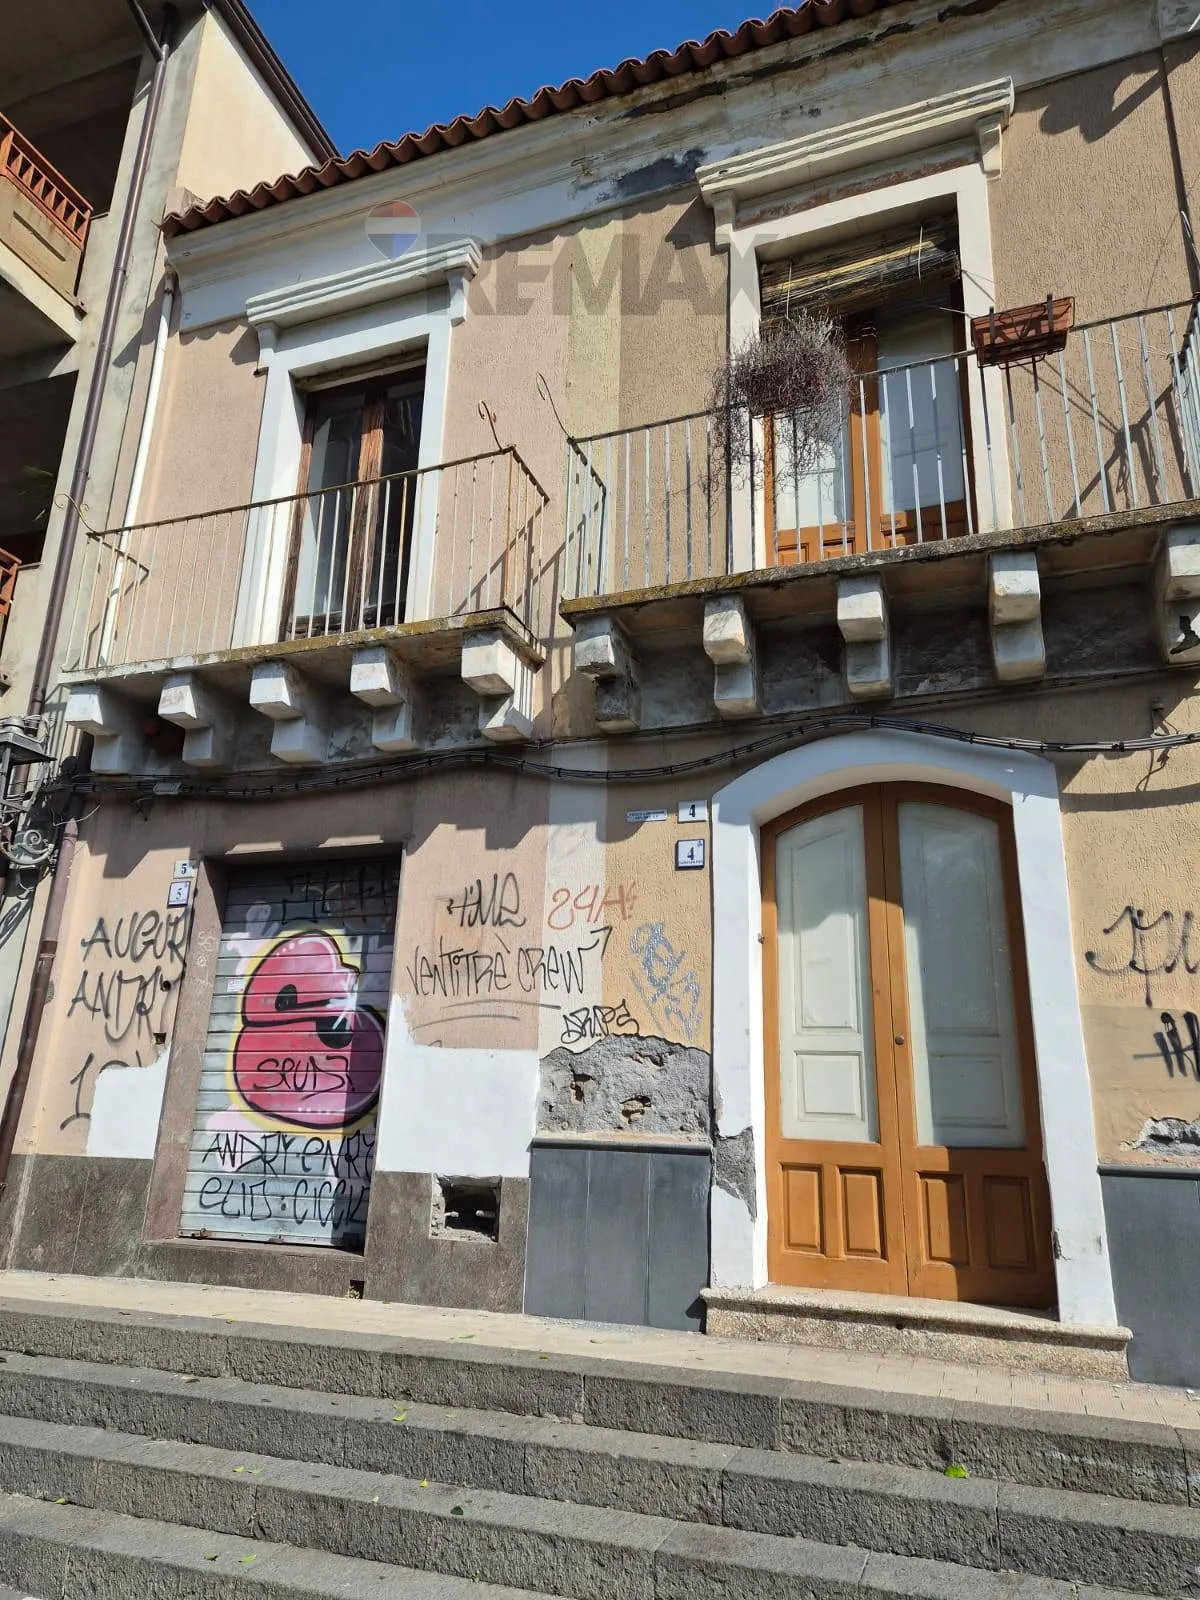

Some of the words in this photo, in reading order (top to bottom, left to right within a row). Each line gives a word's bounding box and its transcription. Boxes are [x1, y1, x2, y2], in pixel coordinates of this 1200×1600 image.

[688, 804, 696, 817] 4
[687, 847, 695, 860] 4
[181, 863, 187, 874] 5
[175, 888, 182, 899] 5
